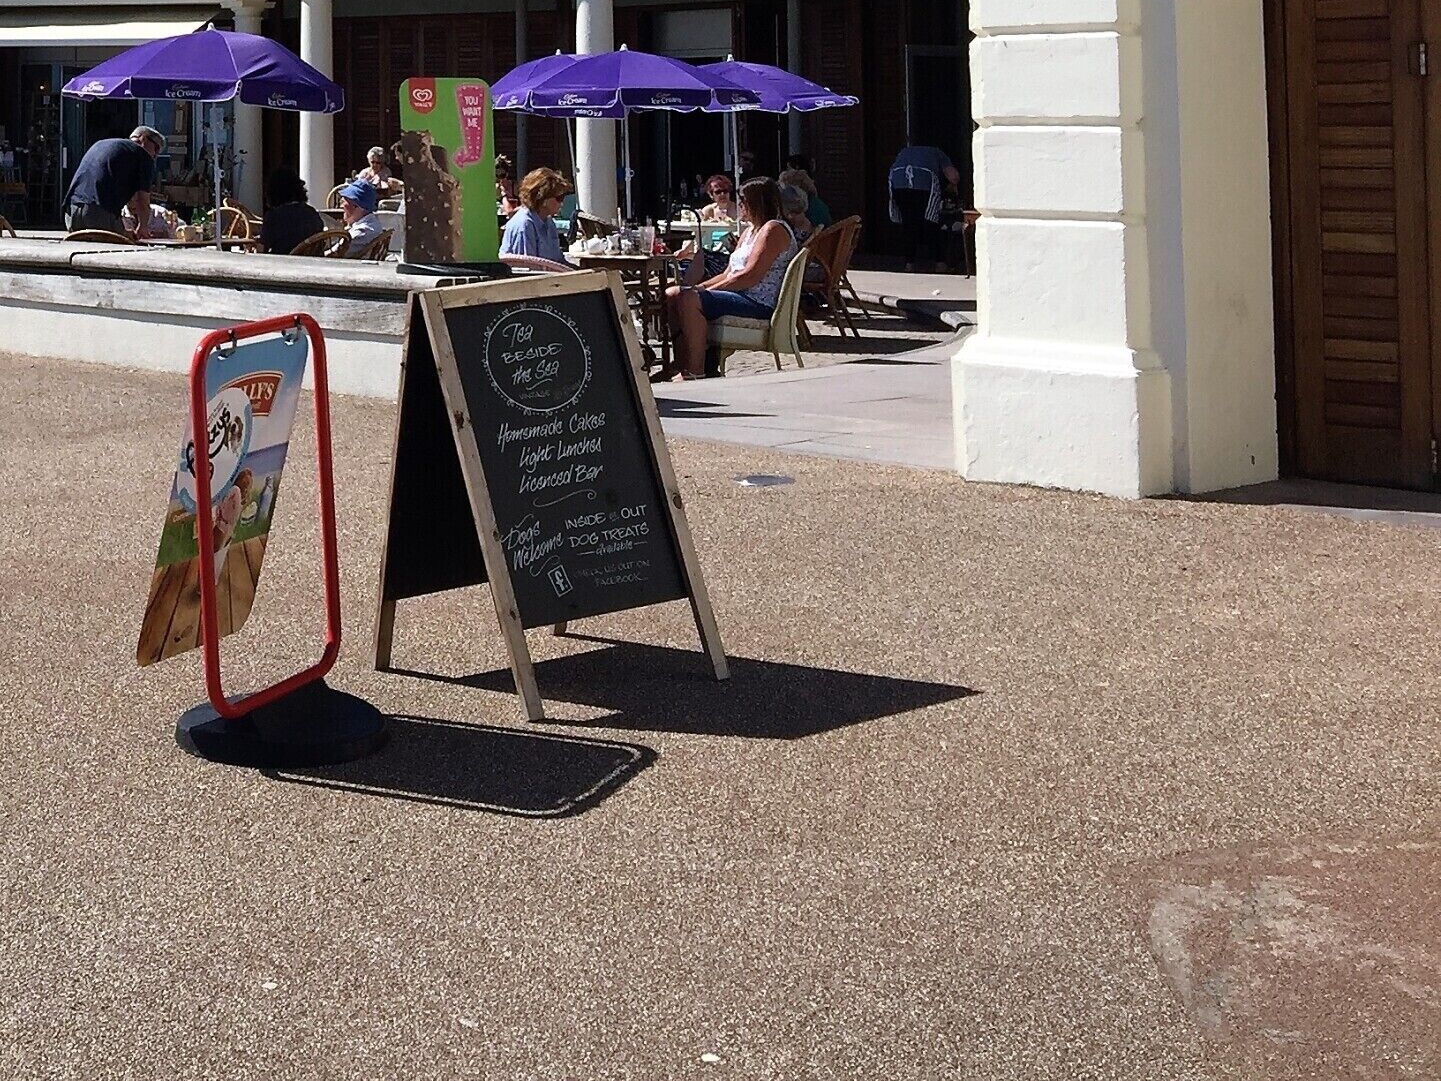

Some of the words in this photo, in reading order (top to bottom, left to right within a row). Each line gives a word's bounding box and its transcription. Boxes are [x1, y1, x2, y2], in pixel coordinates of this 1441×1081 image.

[165, 89, 176, 98] Ice
[176, 89, 202, 98] Cream
[464, 96, 478, 105] YOU
[462, 107, 481, 116] WANT
[467, 118, 478, 127] ME
[502, 323, 534, 347] Tea
[501, 343, 563, 364] BESIDE
[512, 365, 532, 385] the
[534, 359, 560, 380] Sea
[496, 416, 564, 453] Homemade
[569, 412, 606, 434] Cakes
[519, 443, 556, 473] Light
[556, 437, 603, 461] Lunches
[518, 464, 574, 494] Licenced
[575, 464, 604, 483] Bar
[564, 511, 607, 530] INSIDE
[620, 504, 647, 519] OUT
[500, 520, 541, 550] Dogs
[568, 532, 599, 548] DOG
[601, 522, 650, 541] TREATS
[513, 531, 565, 571] Welcome
